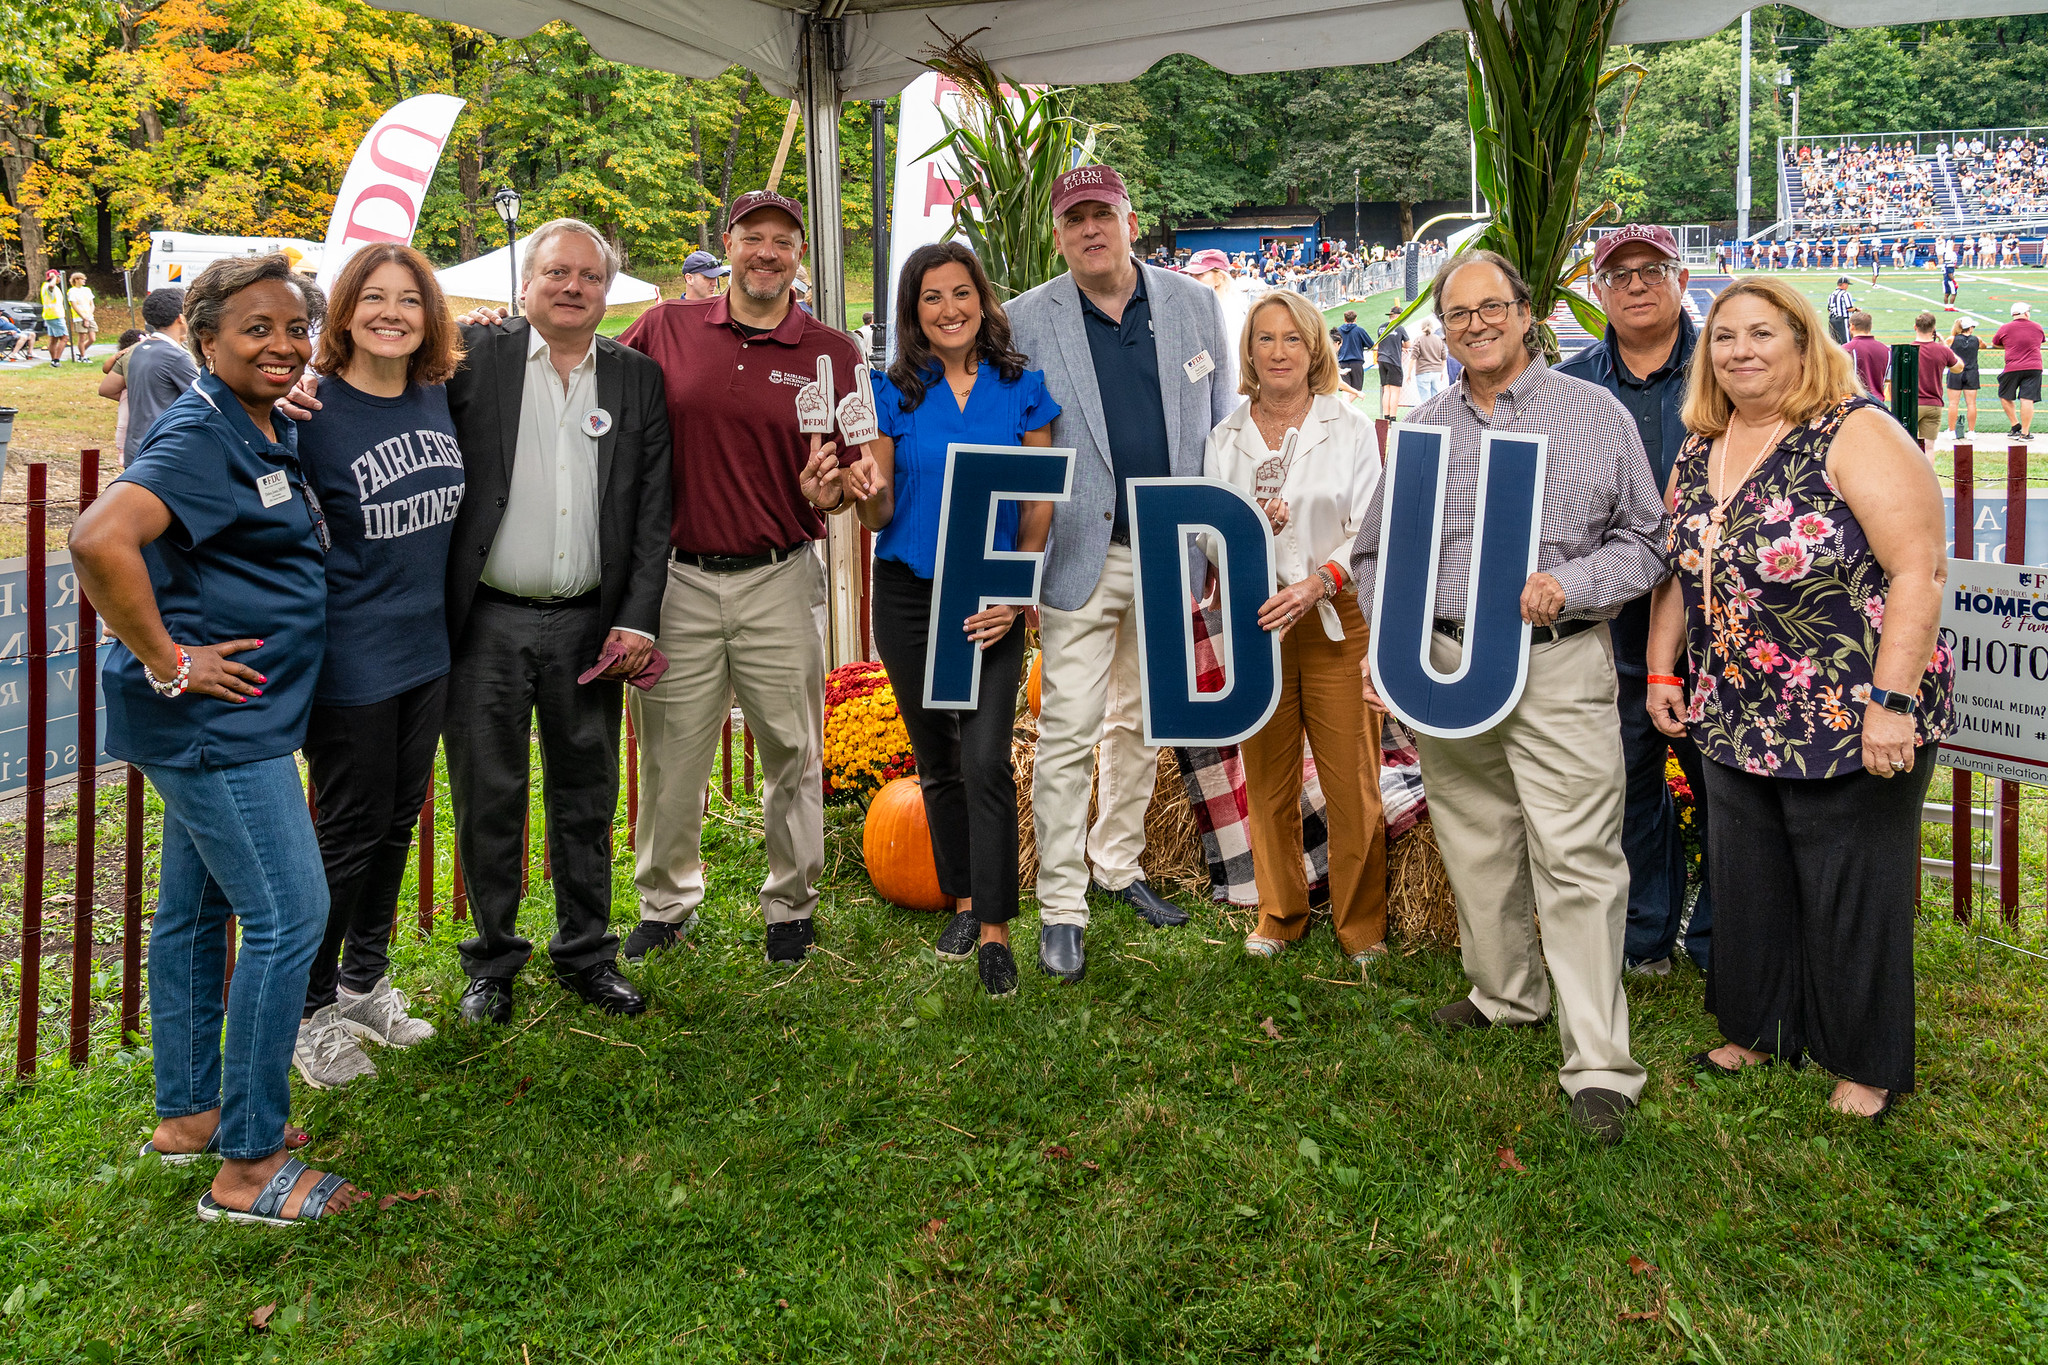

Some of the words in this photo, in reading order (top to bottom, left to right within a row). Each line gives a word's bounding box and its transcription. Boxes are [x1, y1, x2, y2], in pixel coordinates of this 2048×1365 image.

[1072, 170, 1102, 181] FDU
[1064, 177, 1104, 193] ALUMNI
[749, 195, 791, 208] ALUMNI
[1609, 231, 1656, 247] ALUMNI
[1192, 353, 1205, 365] FDU
[855, 426, 874, 438] FDU
[267, 473, 281, 484] FDU
[361, 482, 466, 540] DICKINSO
[1971, 585, 1981, 593] FALL
[1997, 588, 2009, 596] FOOD
[2010, 590, 2028, 598] TRUCKS
[1972, 695, 2005, 711] SOCIAL
[2009, 702, 2047, 719] MEDIA?
[1938, 753, 1951, 763] of
[1953, 755, 1994, 772] Alumni
